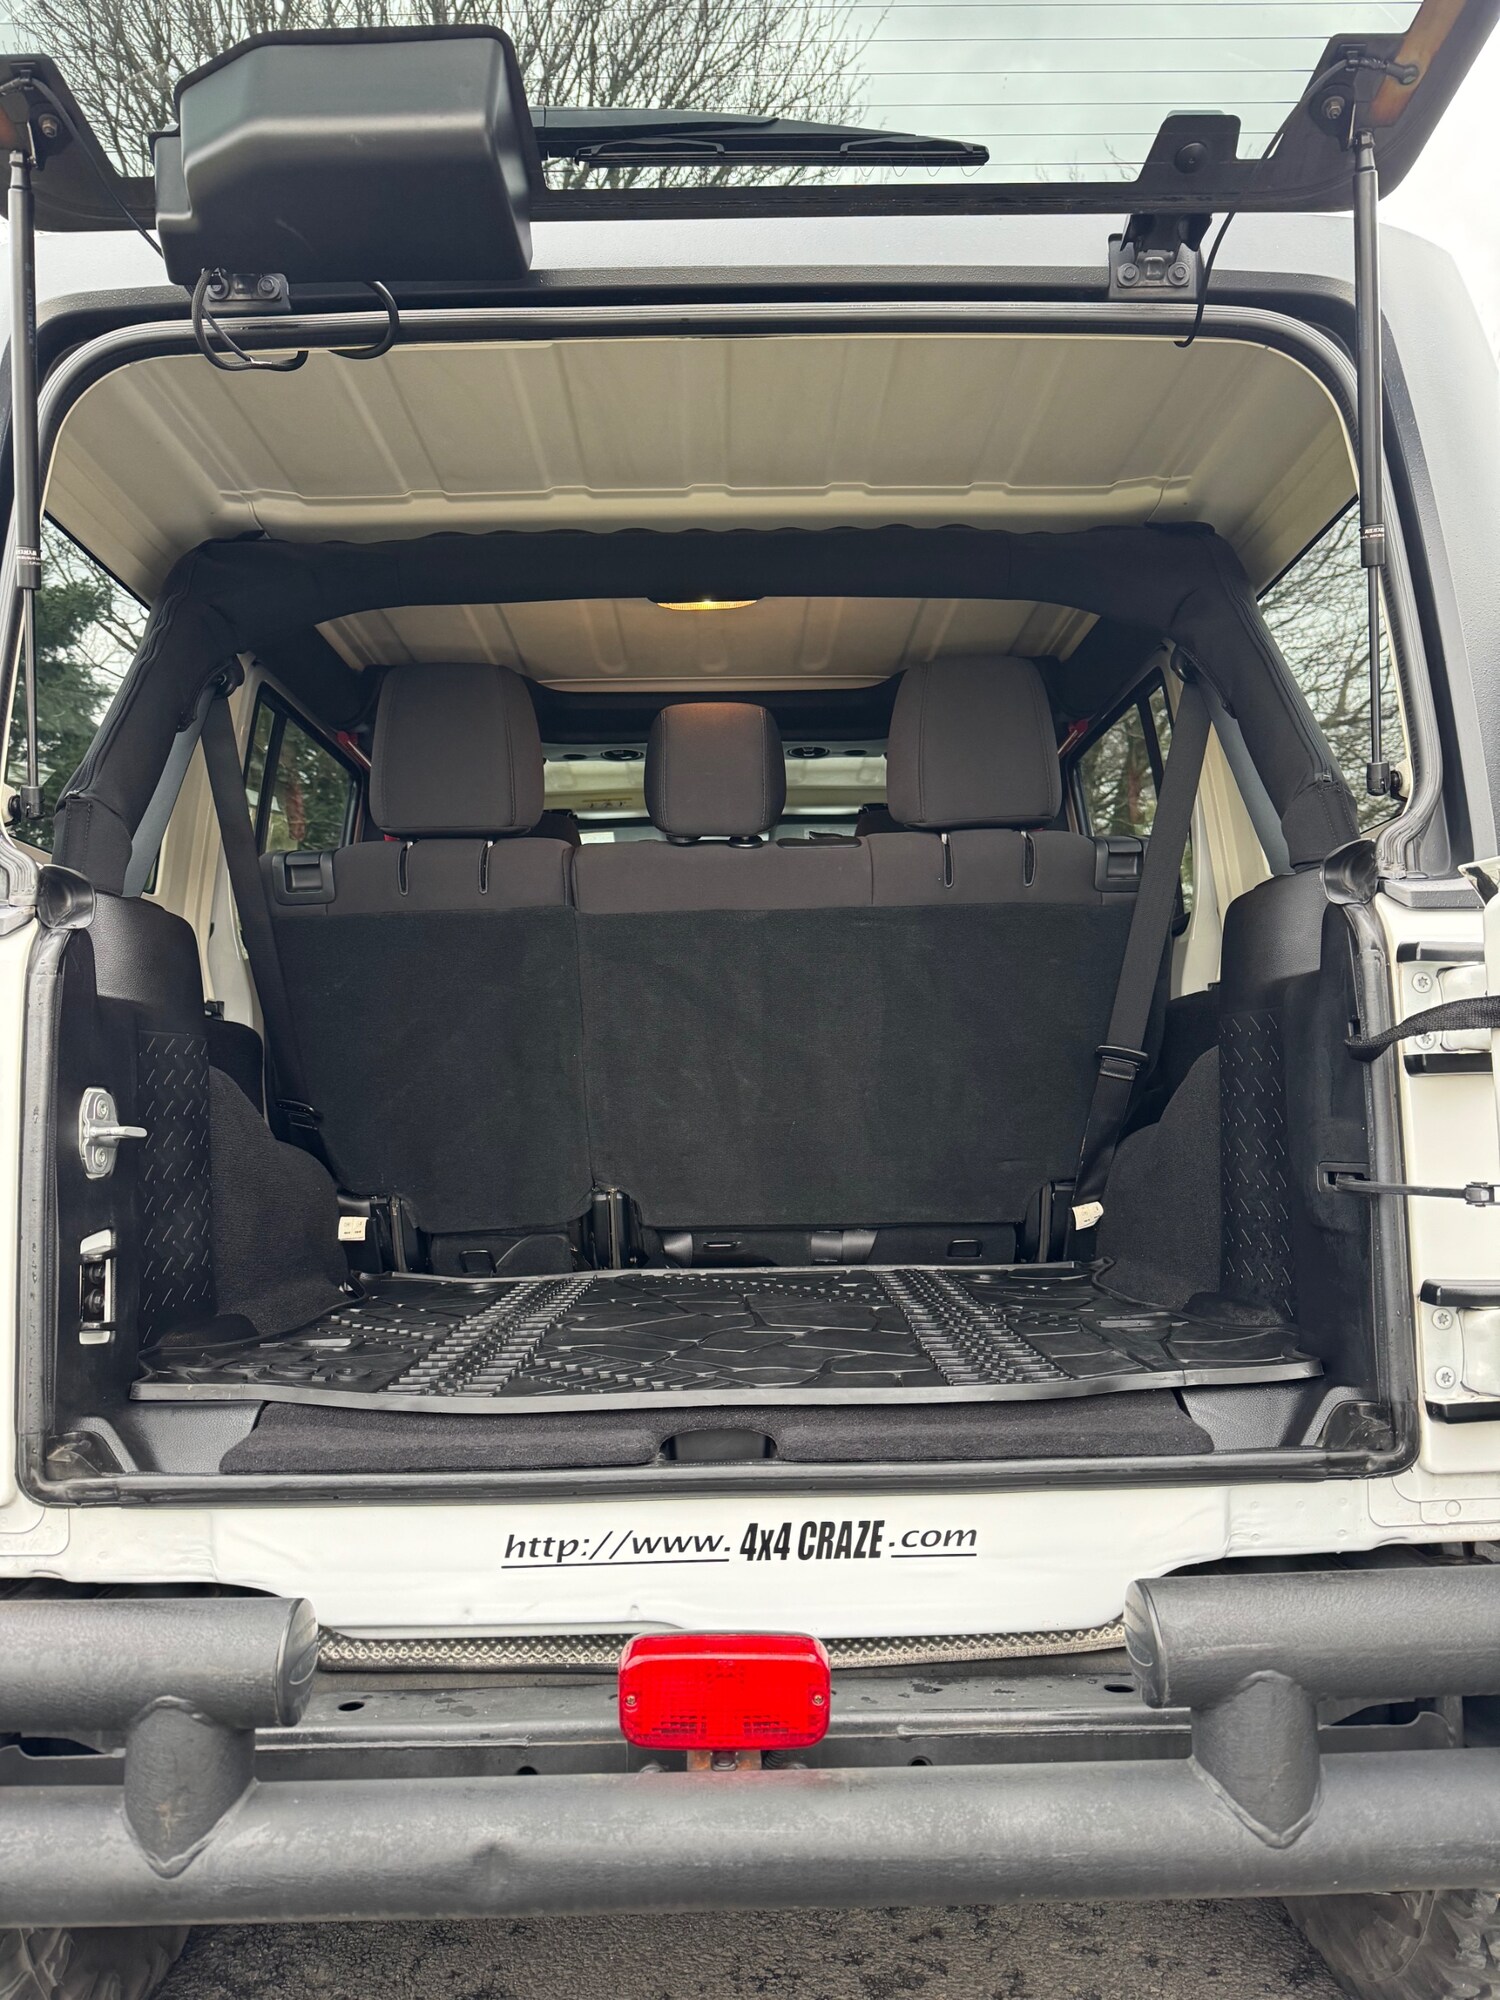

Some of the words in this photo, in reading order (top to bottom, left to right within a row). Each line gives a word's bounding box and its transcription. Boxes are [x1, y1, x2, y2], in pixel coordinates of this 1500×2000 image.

[503, 1530, 731, 1566] http://www.
[739, 1522, 792, 1561] 4x4
[797, 1519, 885, 1561] CRAZE
[889, 1528, 977, 1555] .com
